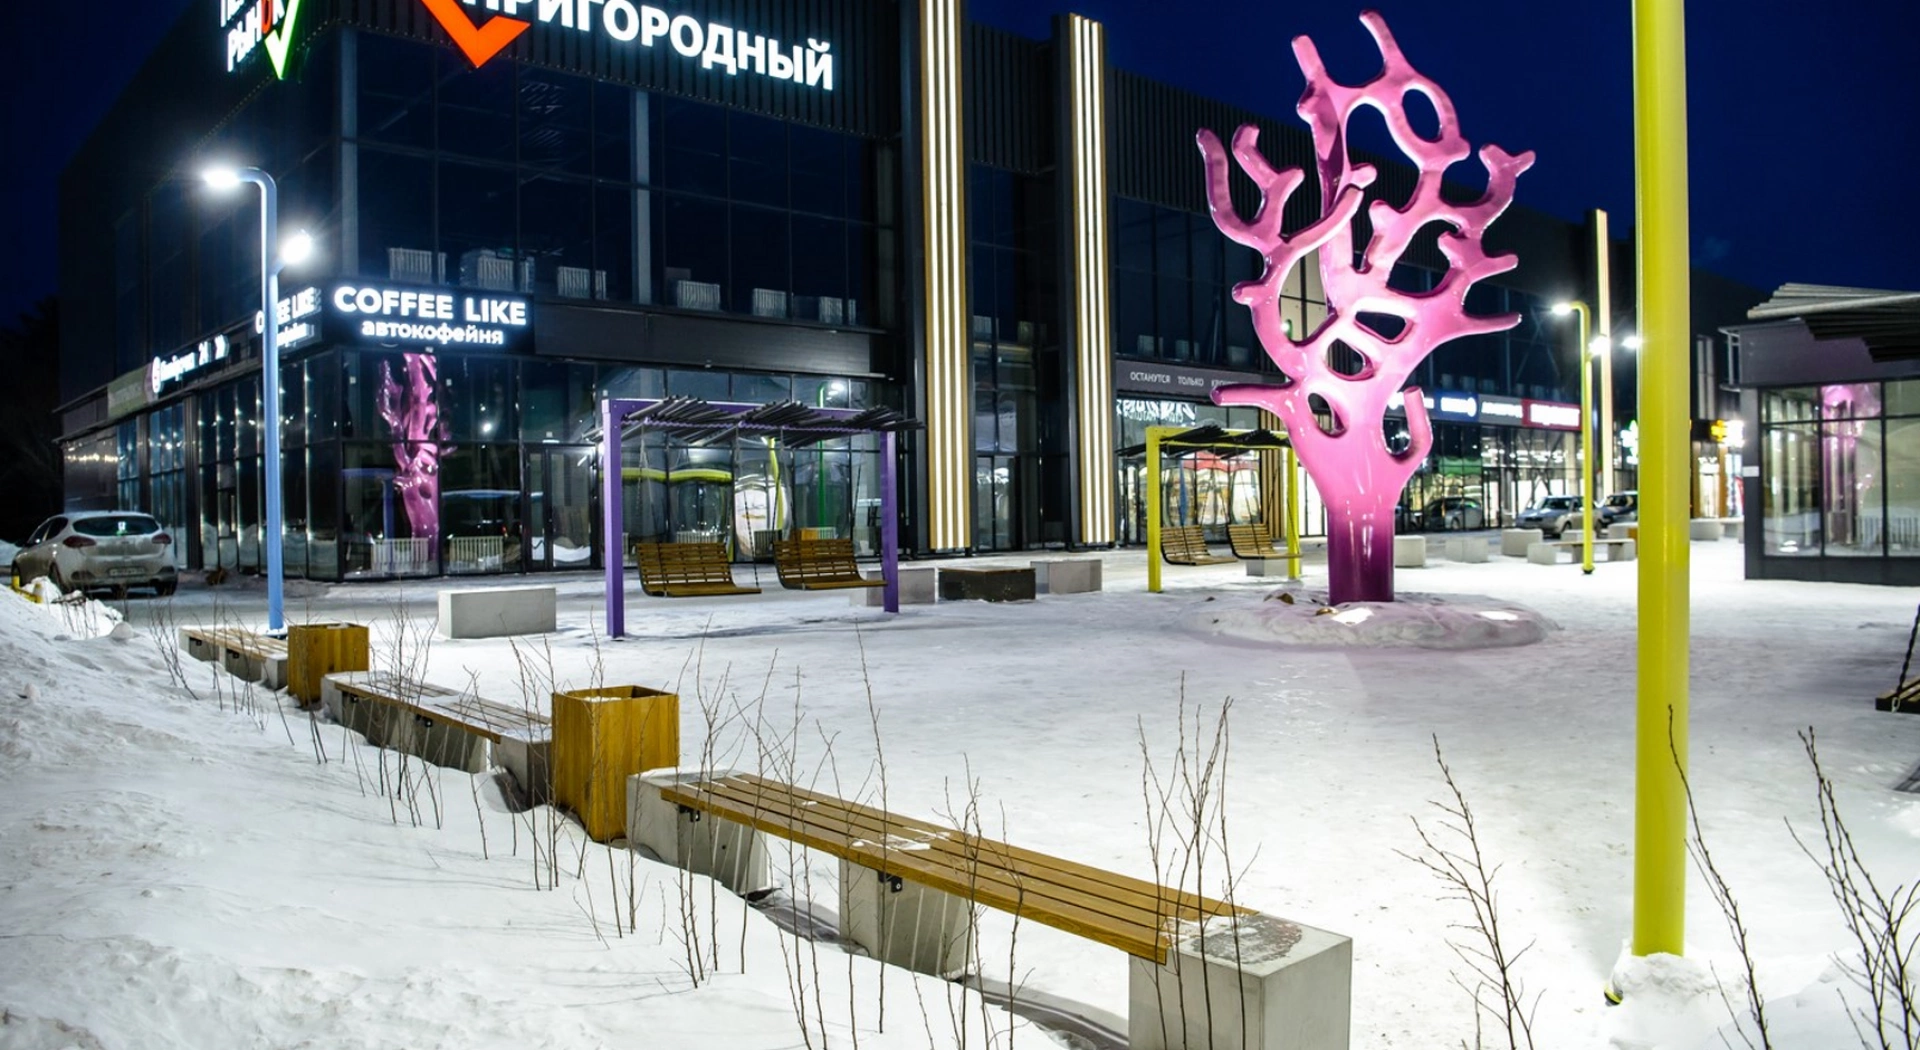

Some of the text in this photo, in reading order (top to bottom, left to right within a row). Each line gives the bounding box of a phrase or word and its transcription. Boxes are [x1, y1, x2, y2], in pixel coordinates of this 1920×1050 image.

[462, 0, 834, 91] ИГОРОДНЫЙ
[333, 286, 527, 326] COFFEE LIKE
[361, 319, 504, 345] автокофейня
[1129, 371, 1171, 384] ОСТАНУТСЯ
[1177, 375, 1204, 387] ТОЛЬКО
